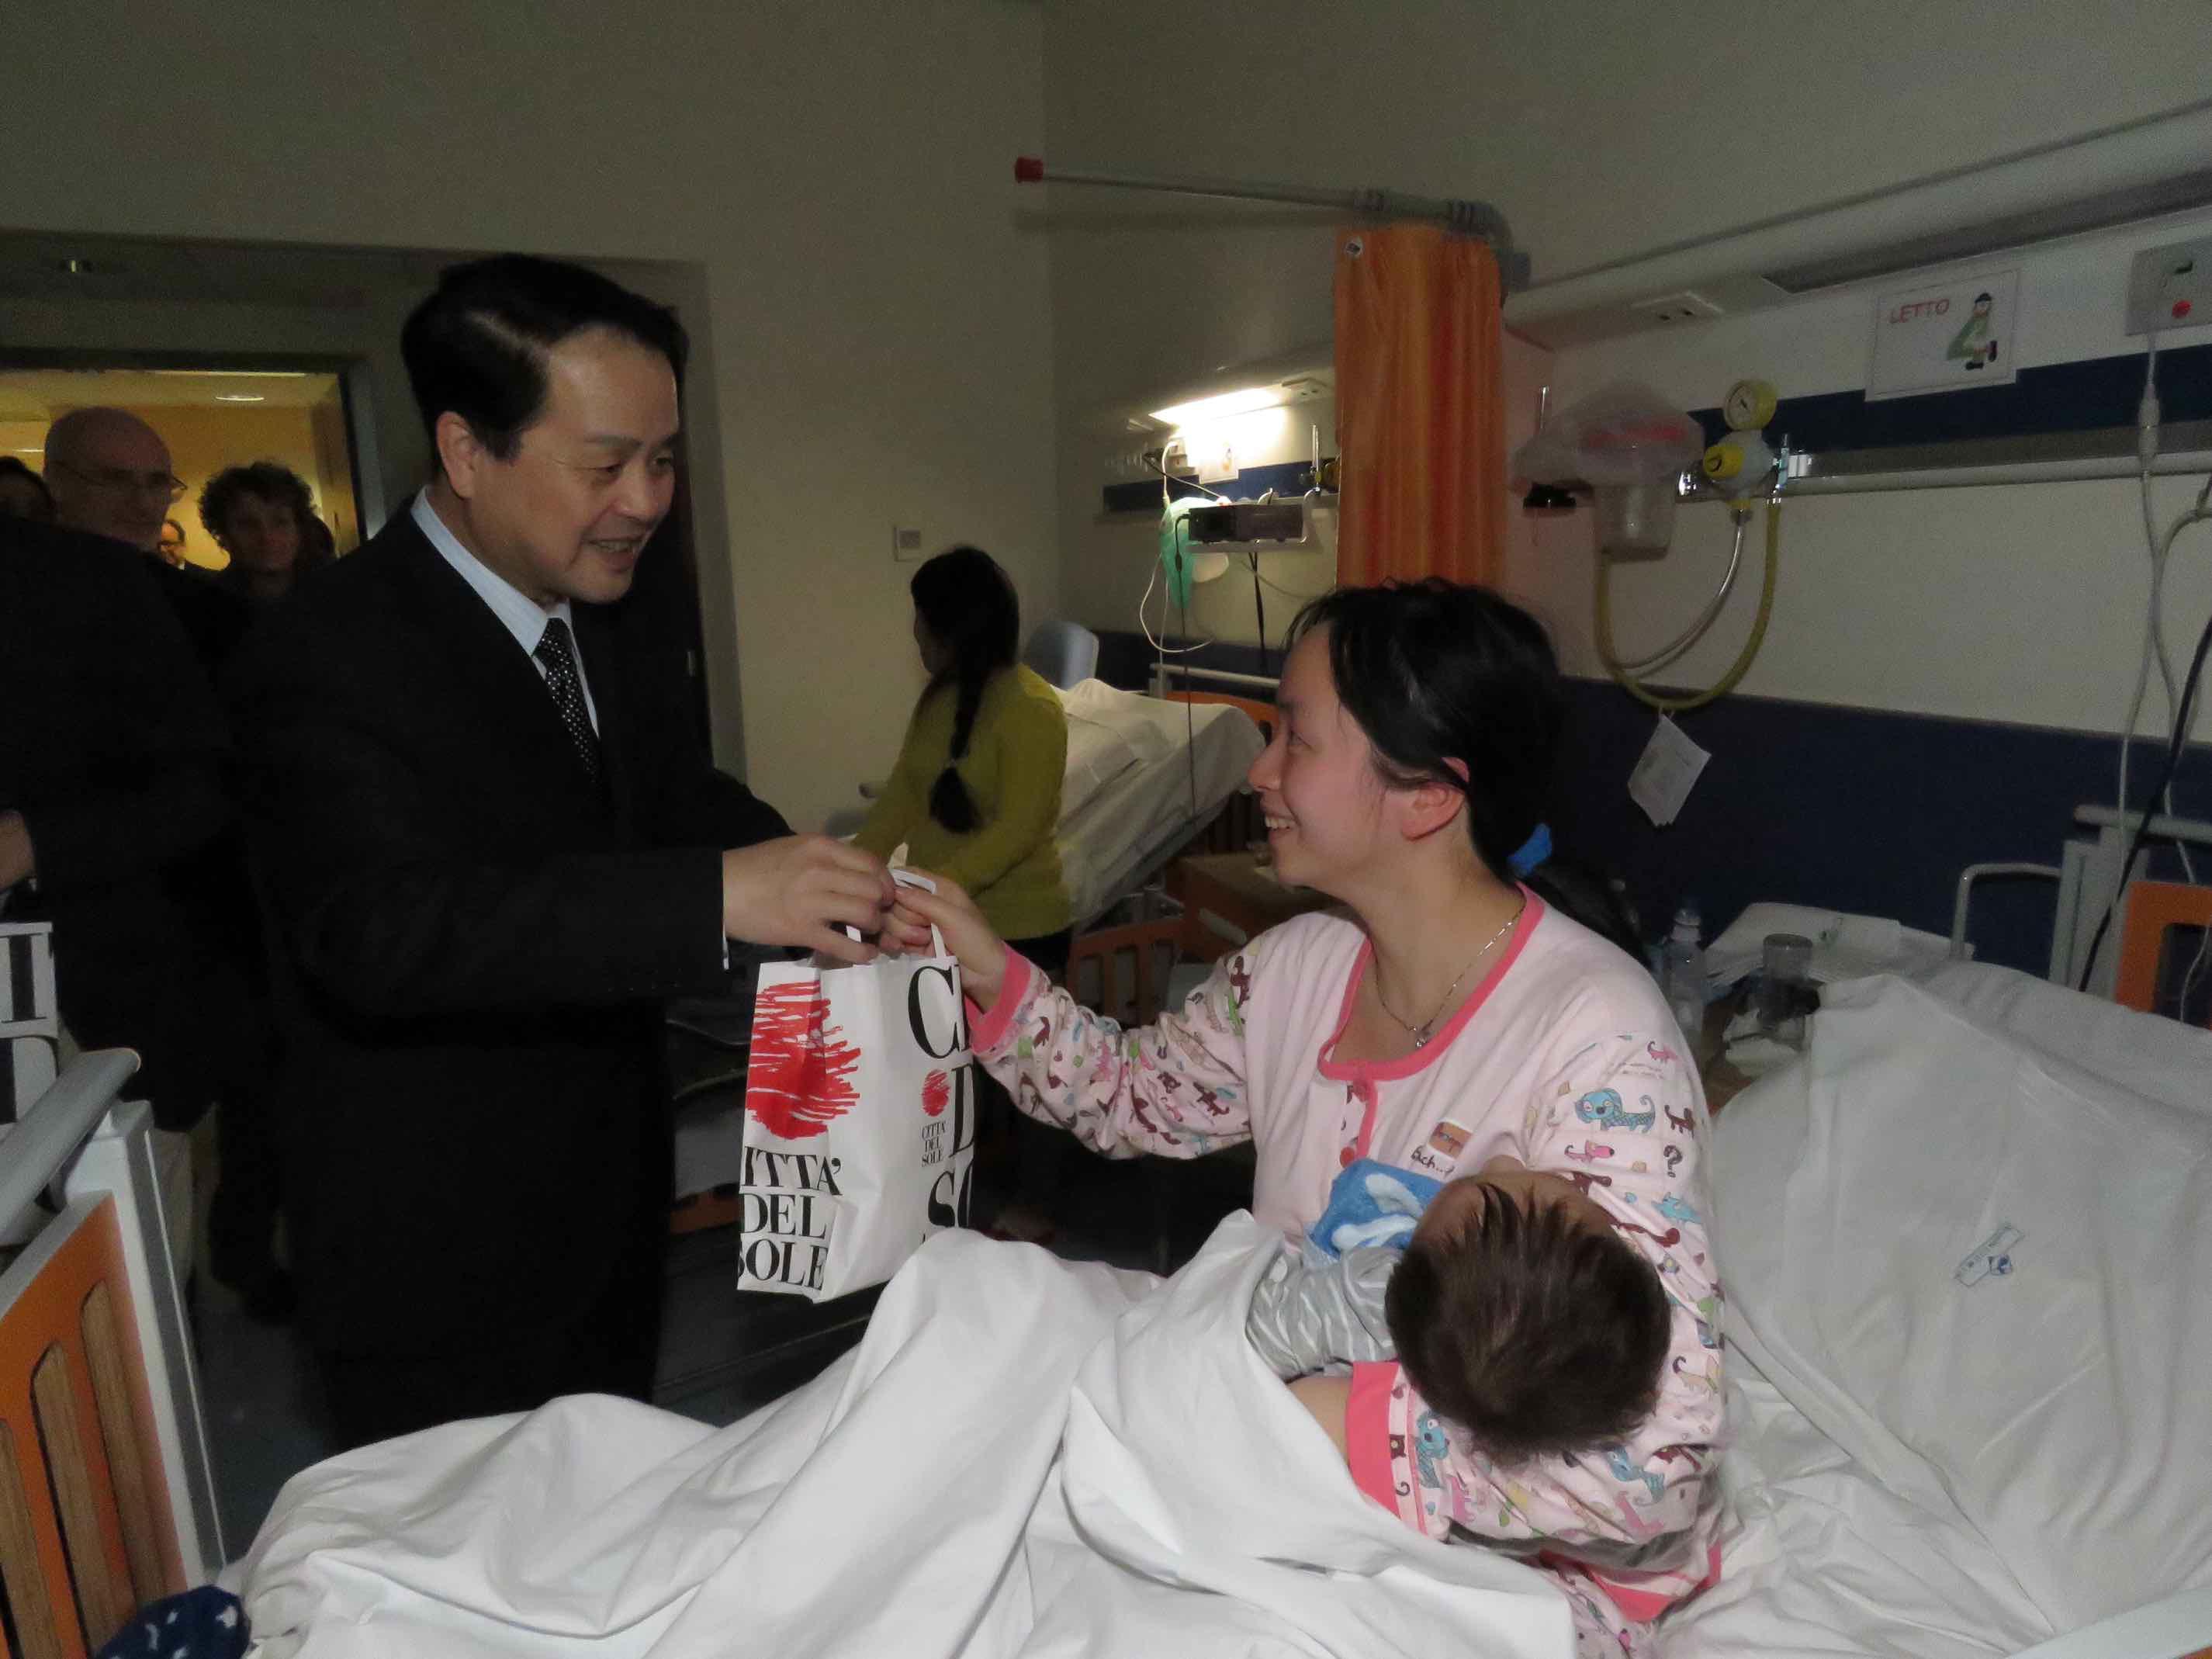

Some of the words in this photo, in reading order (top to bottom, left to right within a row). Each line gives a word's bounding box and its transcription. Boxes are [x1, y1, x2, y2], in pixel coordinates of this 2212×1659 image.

[1888, 298, 1950, 324] LETTO
[737, 1193, 826, 1240] DEL
[738, 1238, 829, 1290] OLE
